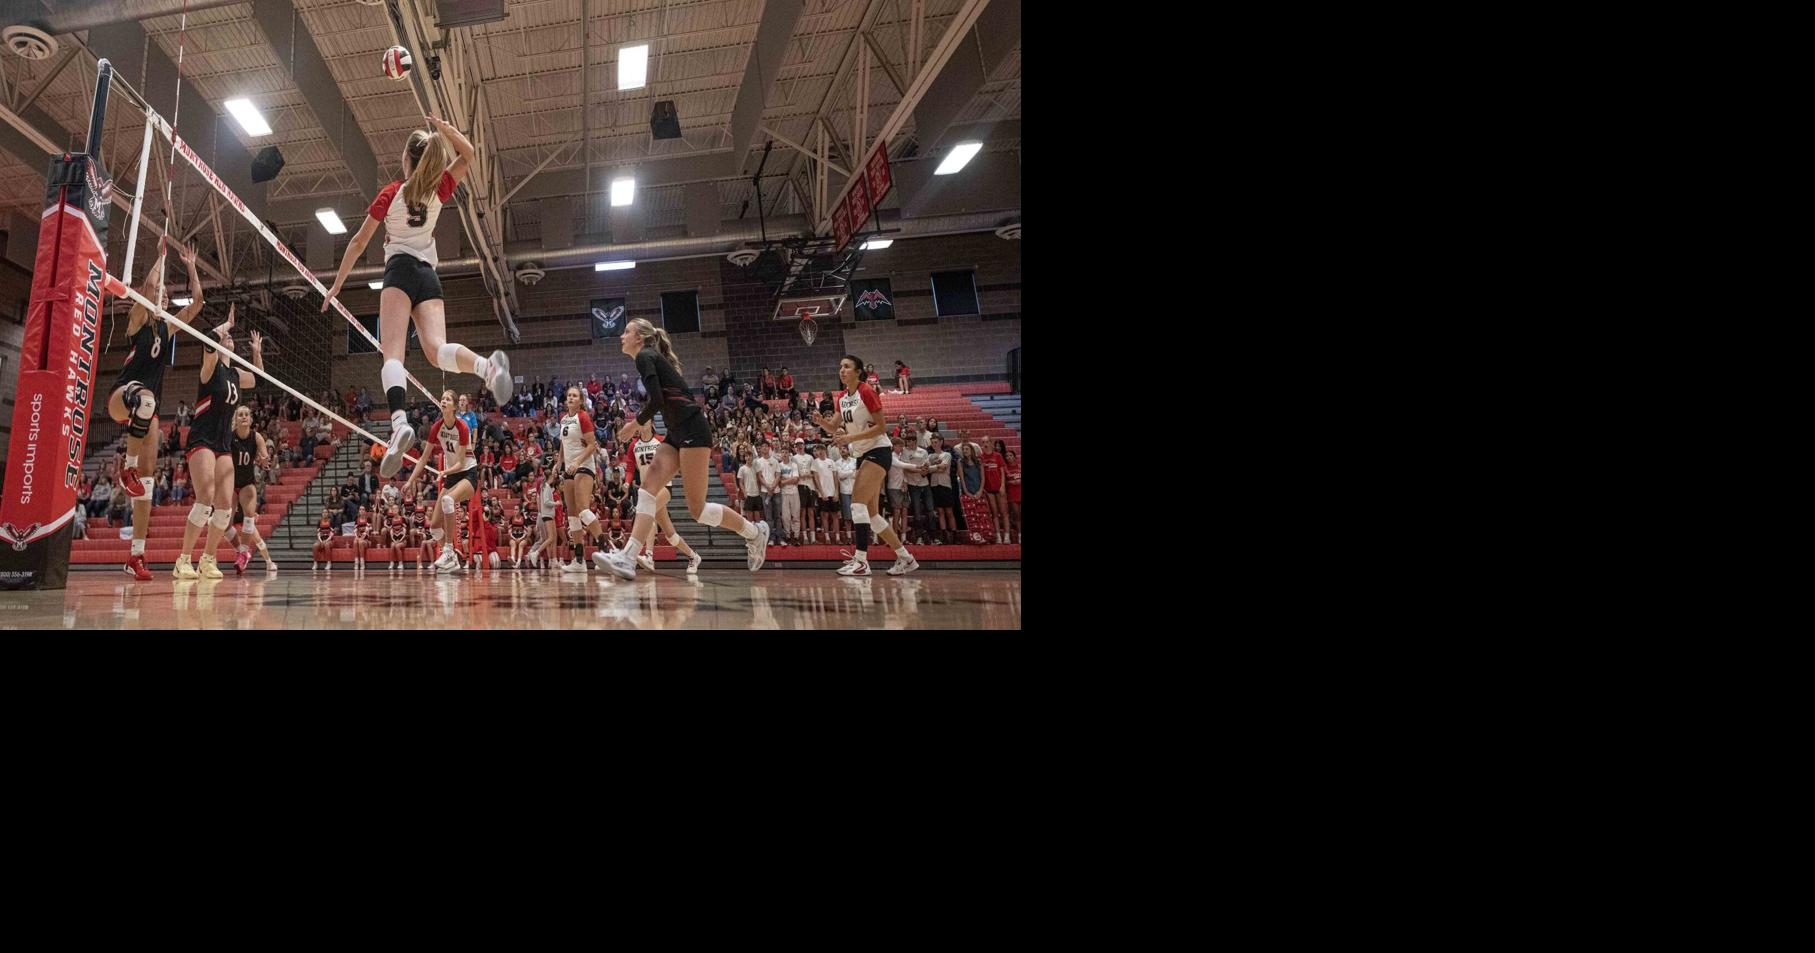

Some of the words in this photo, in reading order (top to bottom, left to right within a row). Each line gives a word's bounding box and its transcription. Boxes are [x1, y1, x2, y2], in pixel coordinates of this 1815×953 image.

[407, 201, 428, 228] 9
[72, 291, 84, 337] RED
[151, 335, 161, 359] 8
[64, 259, 103, 492] MONTROSE
[62, 350, 78, 436] HAWKS
[225, 380, 239, 405] 13
[29, 393, 43, 441] sports
[843, 409, 853, 424] 10
[562, 426, 570, 437] 6
[238, 452, 250, 466] 10
[446, 441, 456, 454] 11
[639, 452, 654, 466] 15
[20, 443, 37, 505] imports
